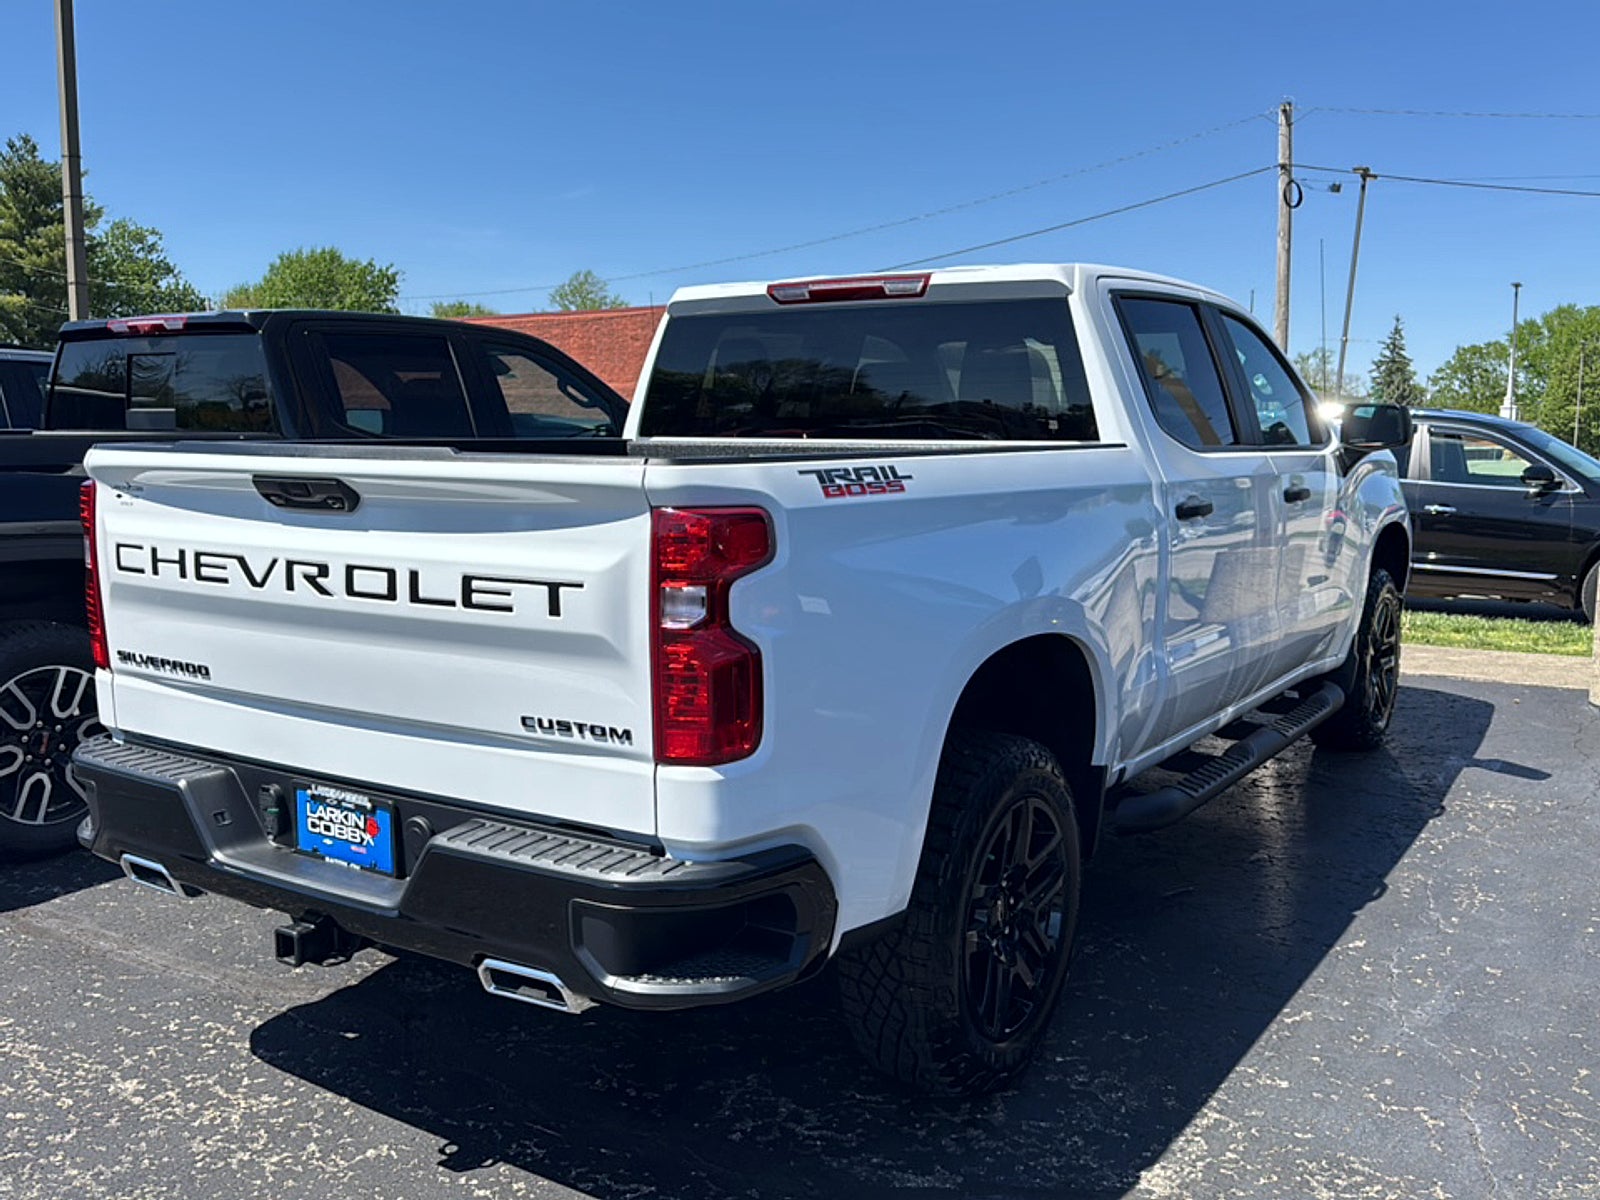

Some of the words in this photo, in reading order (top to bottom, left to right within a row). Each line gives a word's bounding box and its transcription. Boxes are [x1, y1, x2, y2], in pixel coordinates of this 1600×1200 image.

[798, 465, 913, 485] TRAIL
[821, 480, 906, 499] BOSS
[116, 542, 585, 617] CHEVROLET
[117, 650, 211, 678] SILVERADO
[520, 715, 633, 744] CUSTOM
[306, 801, 366, 830] LARKIN
